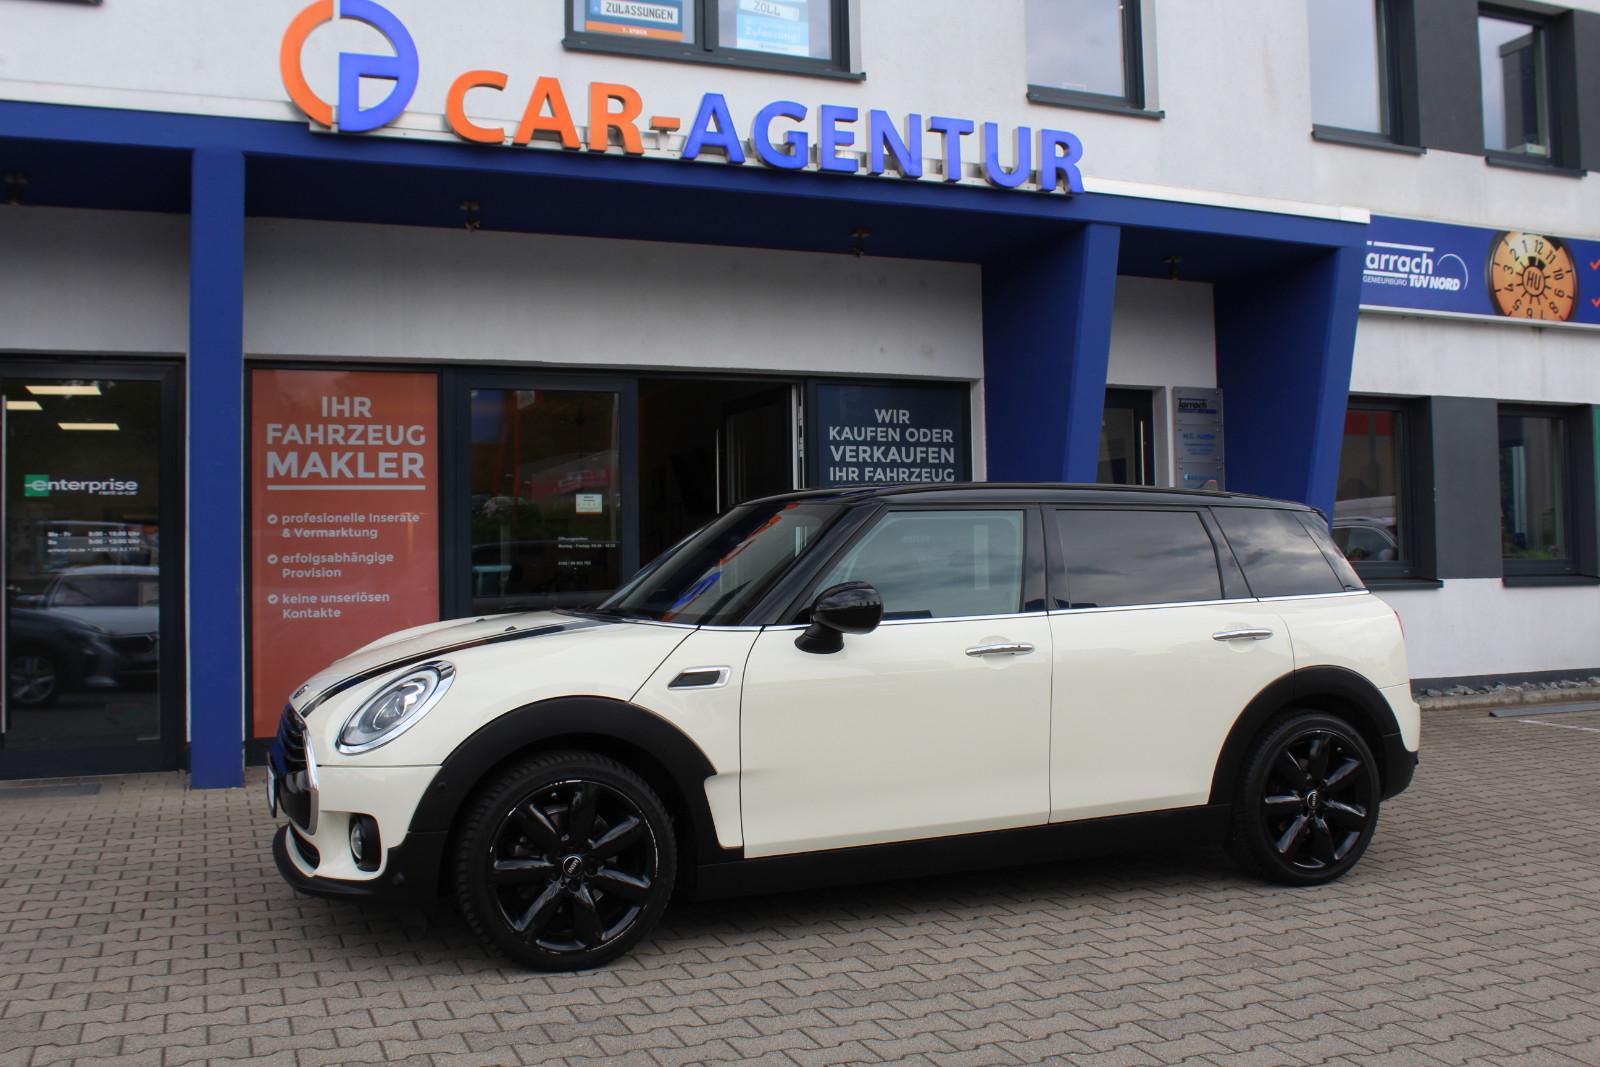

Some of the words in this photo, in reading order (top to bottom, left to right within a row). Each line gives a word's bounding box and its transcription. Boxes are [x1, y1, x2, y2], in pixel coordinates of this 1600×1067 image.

[606, 2, 673, 20] ZULASSUNGEN
[446, 69, 1085, 194] CAR-AGENTUR
[1509, 248, 1520, 261] 2
[1534, 239, 1544, 255] 12
[1365, 252, 1434, 274] arrach
[1503, 264, 1514, 275] 3
[1429, 276, 1461, 291] NORD
[1526, 271, 1541, 290] HU
[321, 396, 372, 418] IHR
[874, 408, 910, 424] WIR
[266, 423, 426, 446] FAHRZEUG
[829, 426, 900, 442] KAUFEN
[905, 428, 953, 443] ODER
[830, 445, 955, 464] VERKAUFEN
[266, 451, 425, 479] MAKLER
[829, 466, 859, 481] IHR
[864, 467, 955, 483] FAHRZEUG
[30, 478, 138, 494] enterprise
[369, 512, 420, 524] Inserate
[282, 528, 291, 538] &
[294, 527, 378, 540] Vermarktung
[282, 552, 395, 565] erfolgsabhängige
[282, 567, 342, 578] Provision
[282, 593, 317, 604] keine
[320, 592, 390, 604] unseriösen
[282, 607, 342, 619] Kontakte
